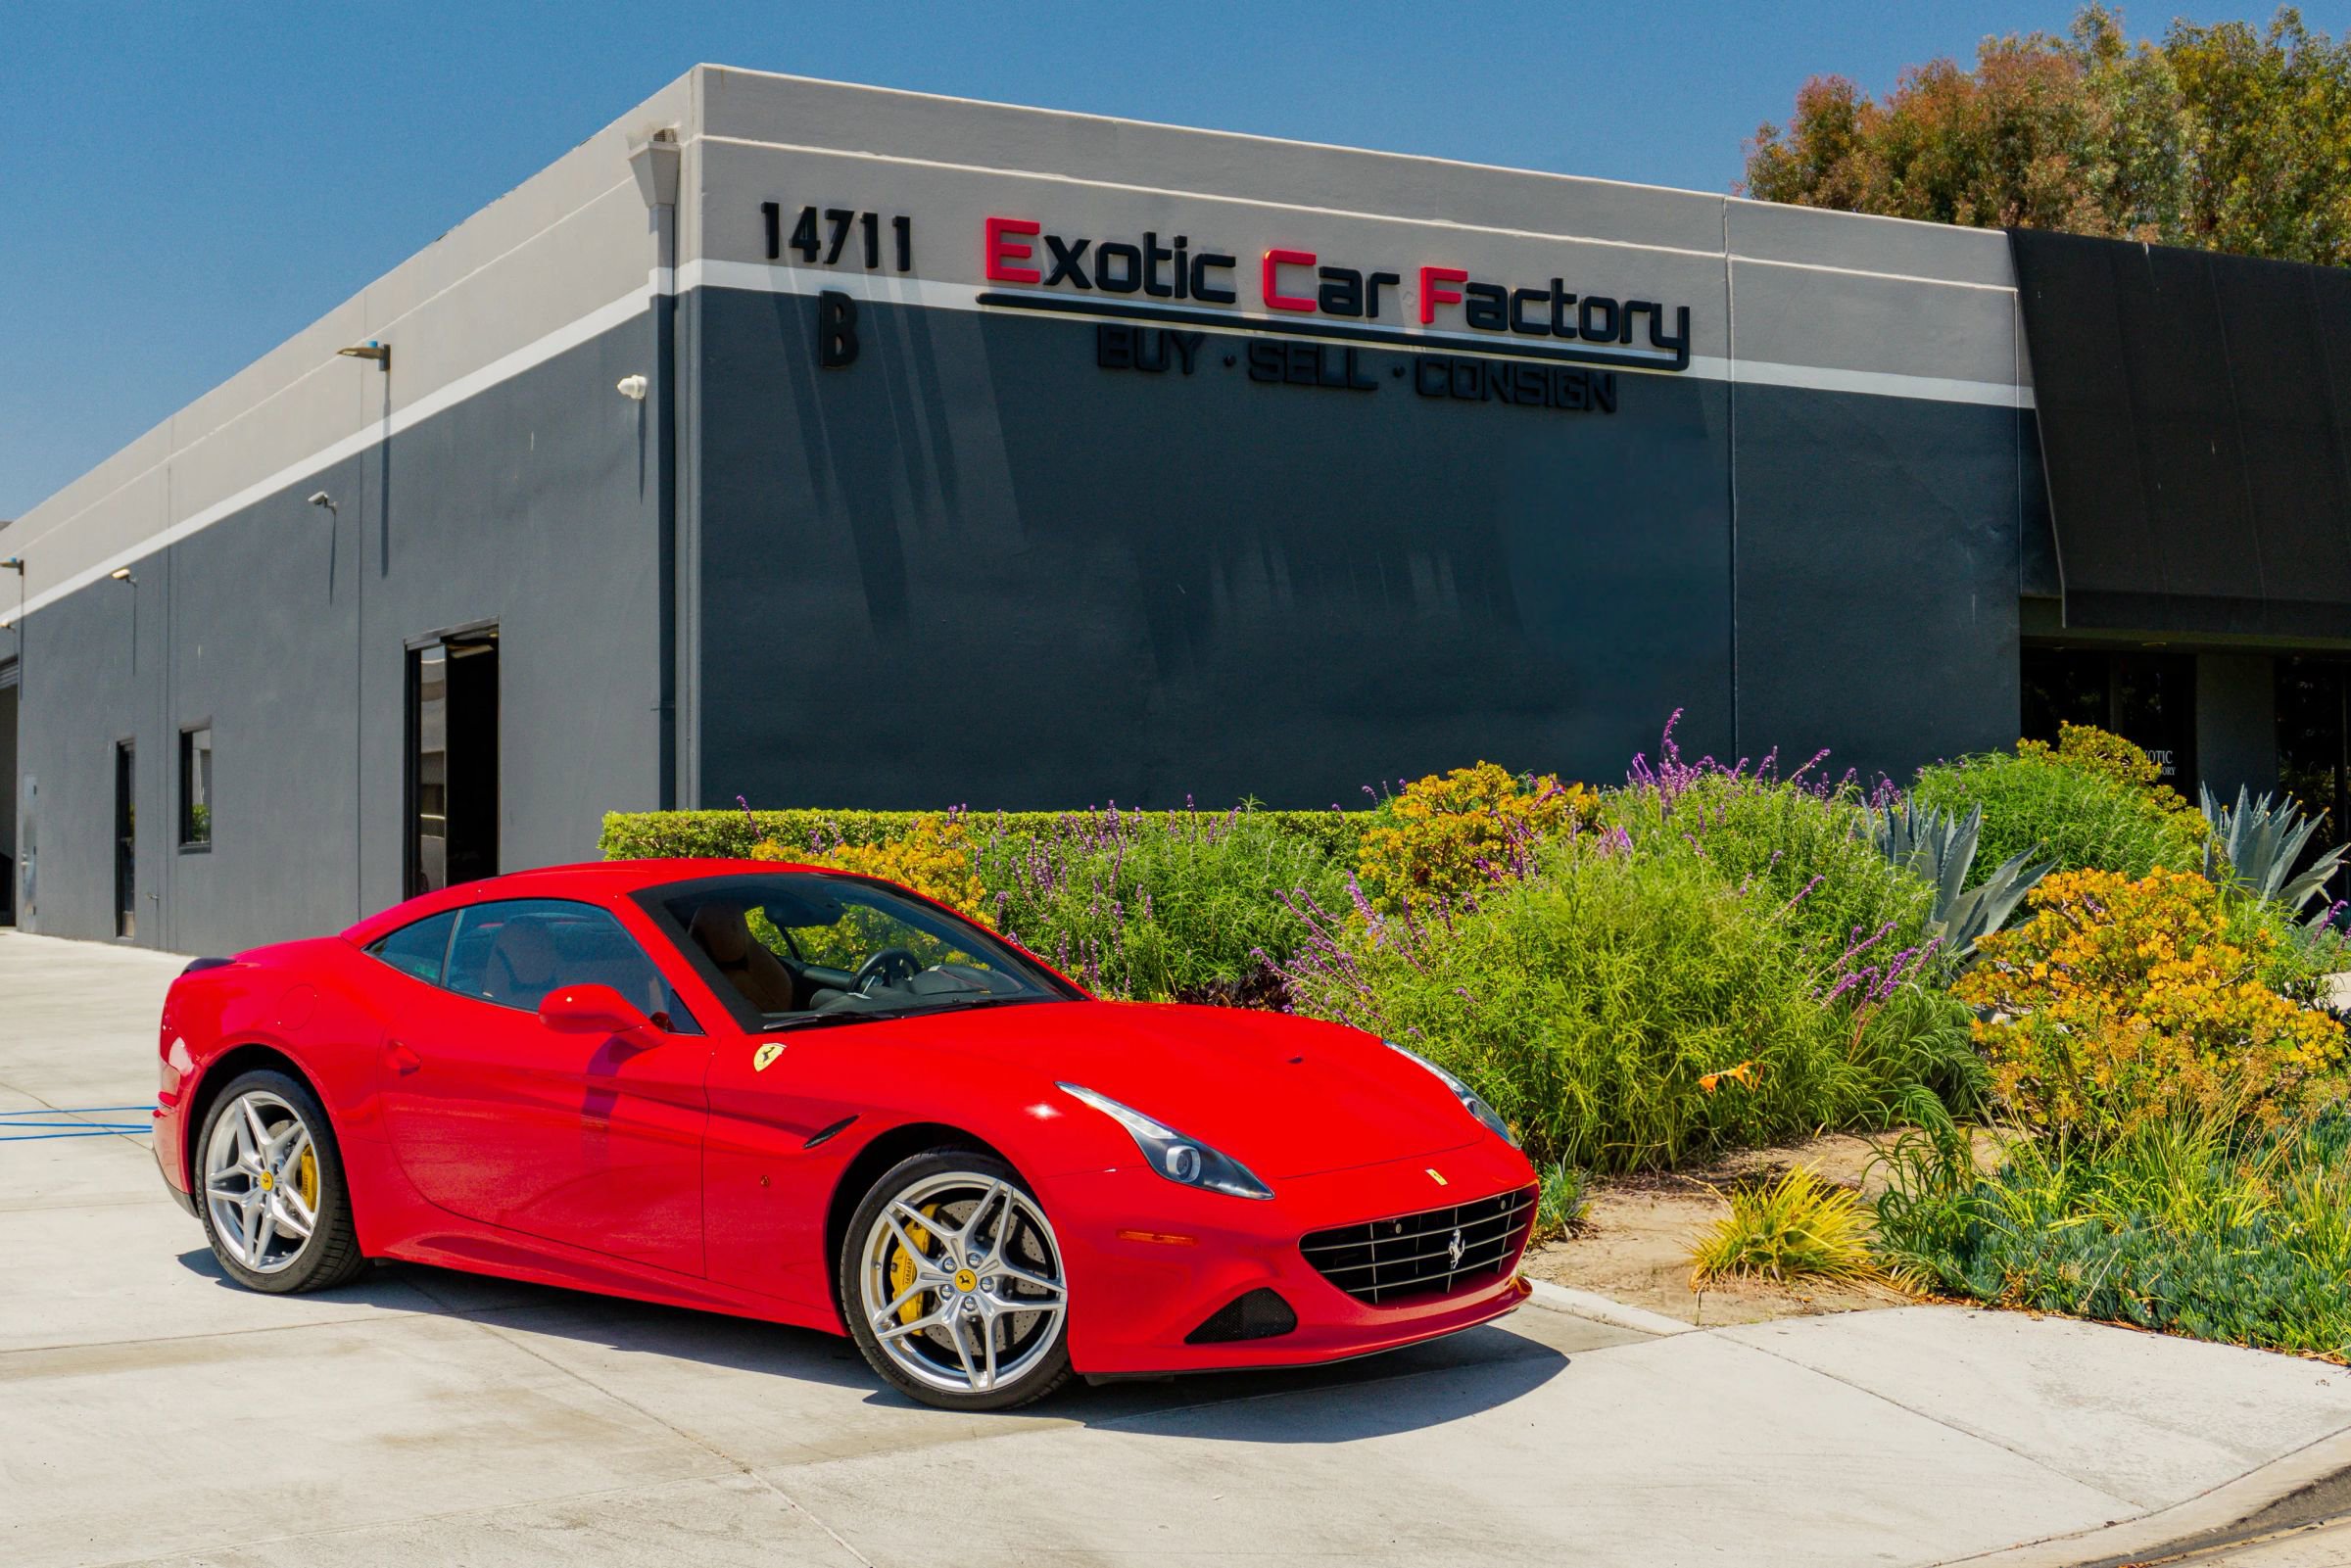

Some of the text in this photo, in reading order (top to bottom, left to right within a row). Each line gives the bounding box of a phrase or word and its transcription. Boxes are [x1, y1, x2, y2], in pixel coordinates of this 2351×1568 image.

[761, 202, 911, 271] 14711
[819, 290, 859, 369] B
[985, 217, 1691, 371] Exotic Car Factory
[1097, 324, 1617, 414] BUY SELL CONSIGN
